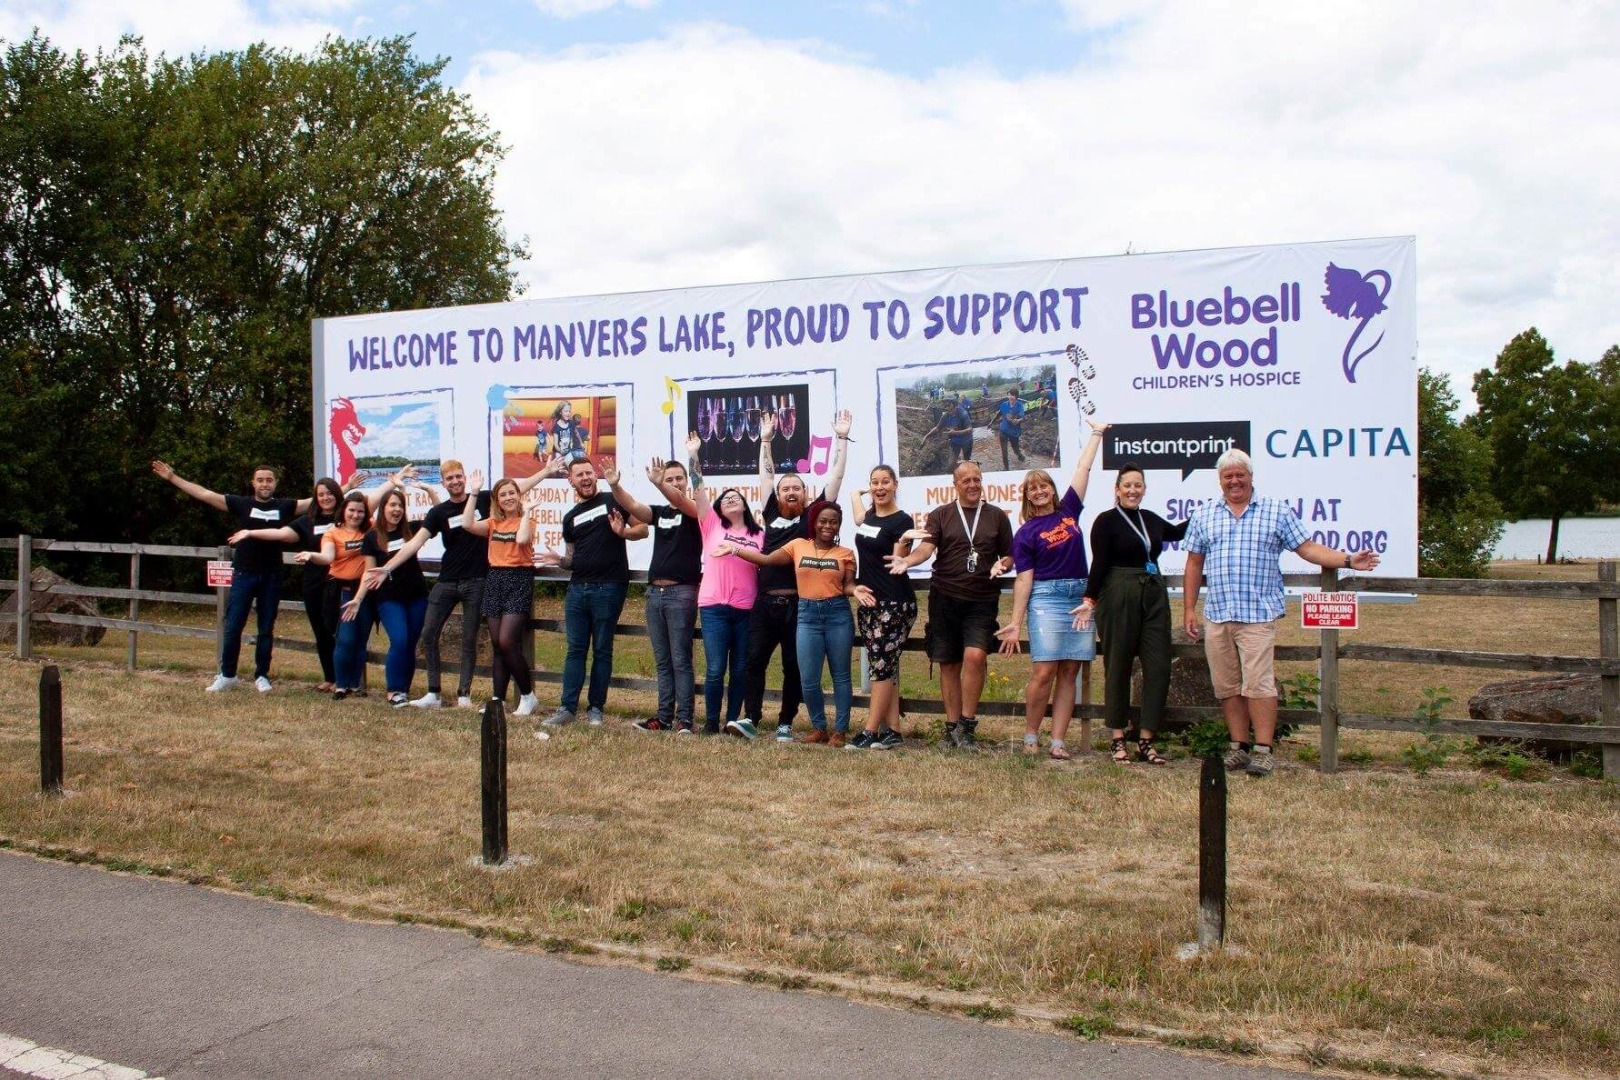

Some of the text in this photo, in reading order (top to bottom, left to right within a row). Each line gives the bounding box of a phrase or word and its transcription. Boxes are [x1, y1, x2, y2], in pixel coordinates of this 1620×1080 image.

[1131, 281, 1300, 329] Bluebell
[348, 286, 1089, 372] WELCOME TO MANVERS LAKE, PROUD TO SUPPORT
[1151, 326, 1277, 370] Wood
[1133, 371, 1301, 390] CHILDREN'S HOSPICE
[1114, 435, 1236, 458] instantprint
[1266, 427, 1412, 459] CAPITA
[1311, 498, 1341, 522] AT
[1303, 593, 1356, 602] POLITE NOTICE
[1305, 604, 1354, 614] NO PARKING
